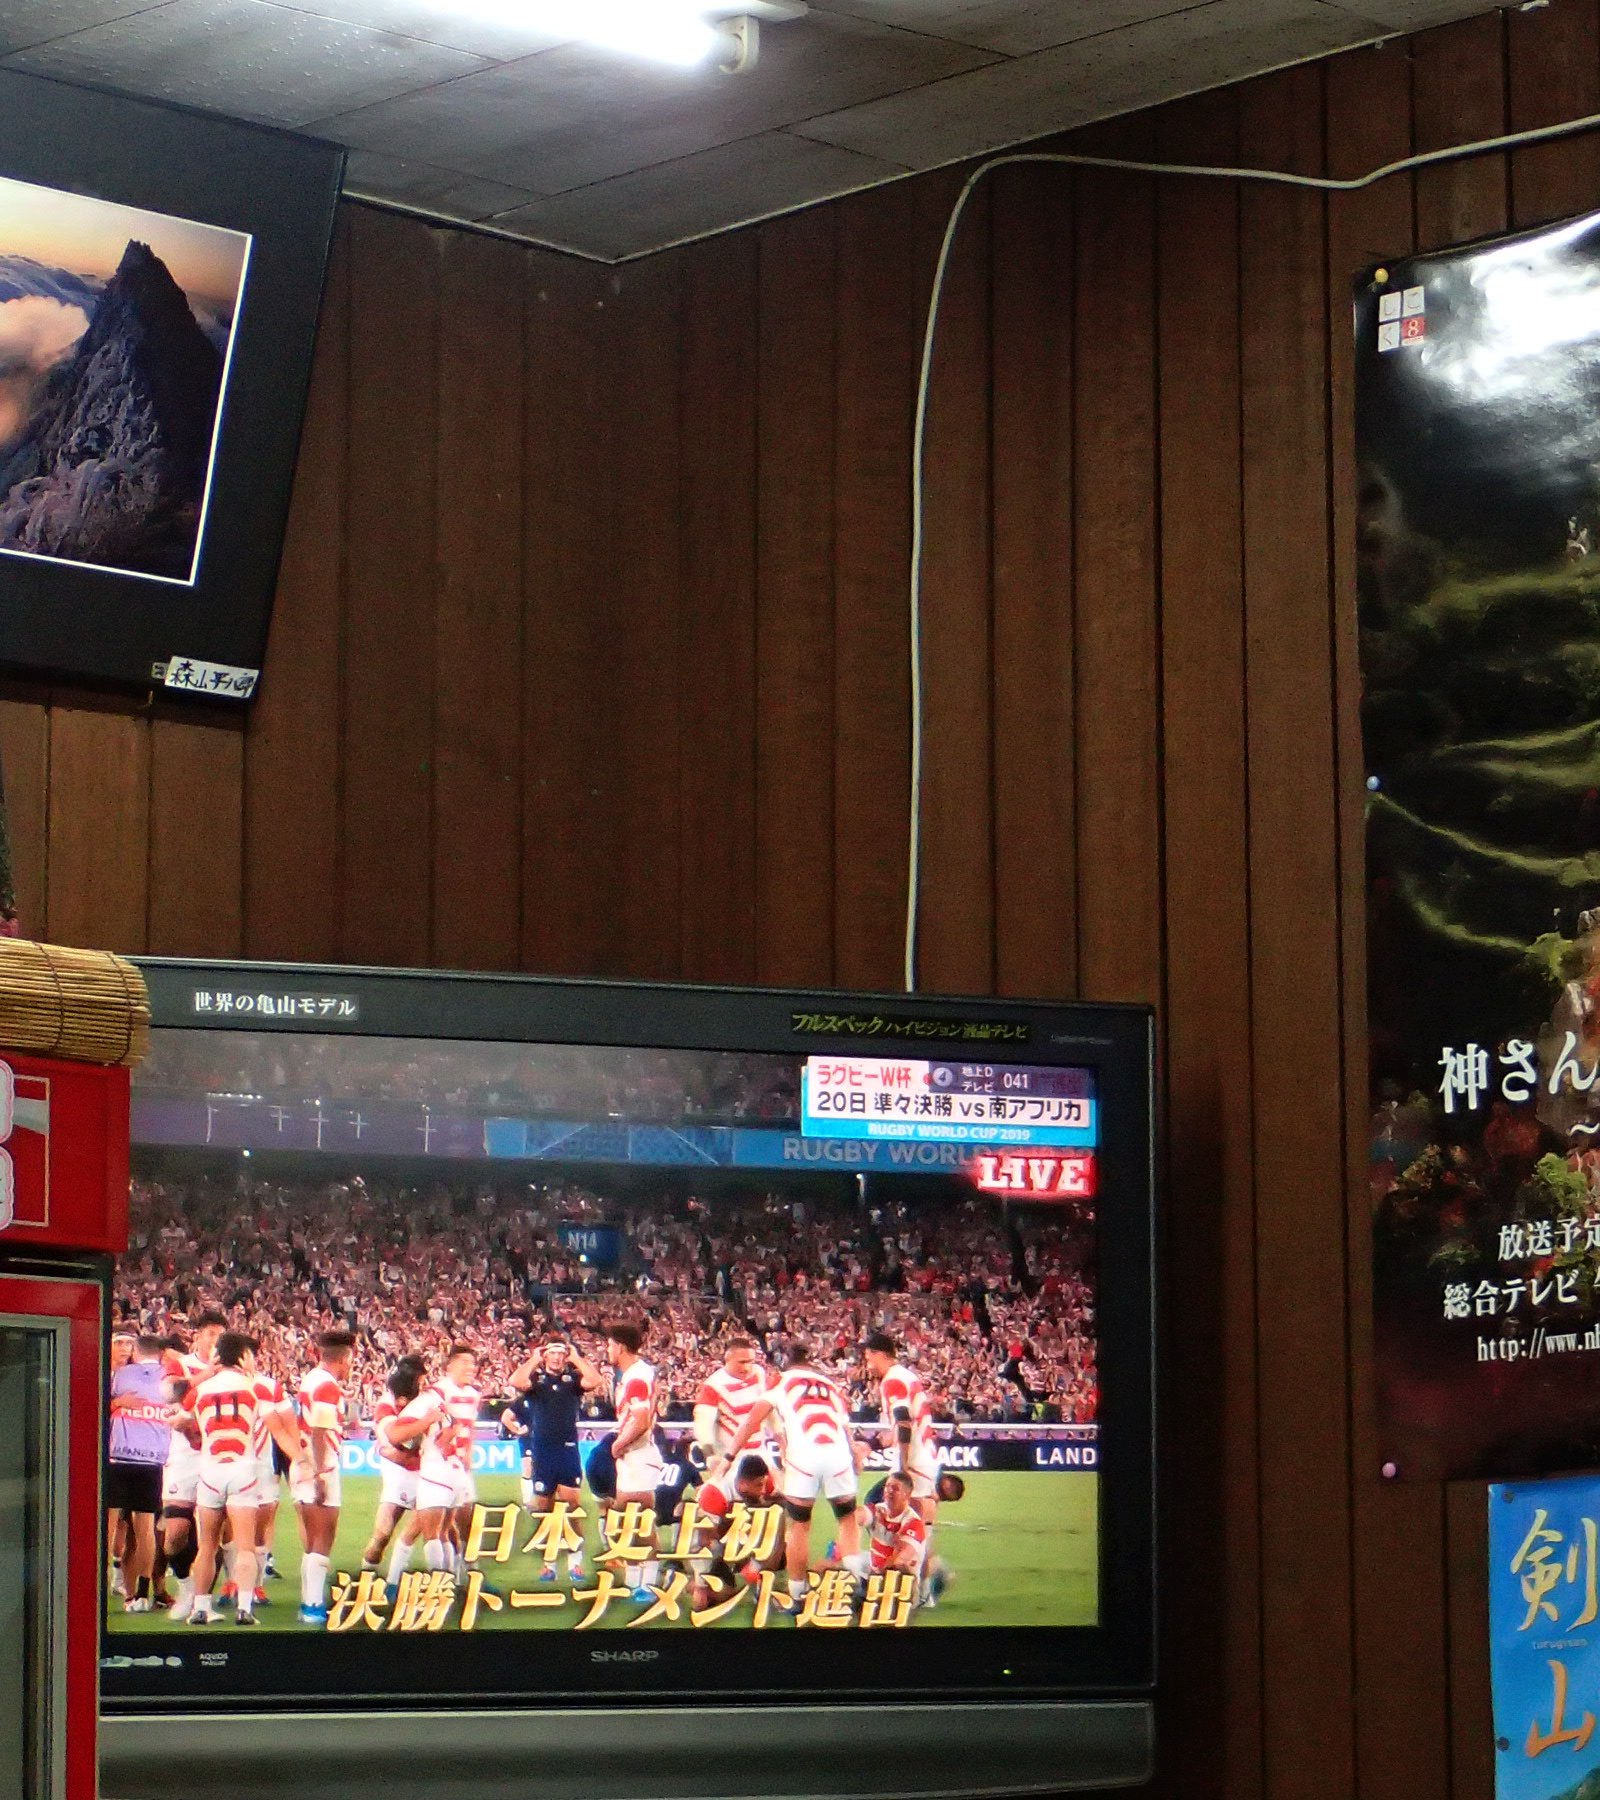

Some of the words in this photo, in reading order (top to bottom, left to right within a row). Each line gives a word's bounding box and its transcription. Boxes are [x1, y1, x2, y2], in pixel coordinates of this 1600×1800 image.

[195, 991, 355, 1016] 世界の亀山モデル
[818, 1064, 911, 1089] ラグビーW杯
[961, 1081, 994, 1093] テレビ
[1003, 1070, 1029, 1089] 041
[817, 1091, 866, 1113] 20日
[874, 1092, 952, 1117] 準々決勝
[989, 1096, 1082, 1122] 南アフリカ
[868, 1123, 914, 1137] RUGBY
[919, 1125, 967, 1139] WORLD
[971, 1127, 997, 1139] CUP
[1000, 1128, 1030, 1141] 2019
[783, 1137, 878, 1163] RUGBY
[978, 1156, 1087, 1191] LIVE
[567, 1231, 598, 1250] N14
[1443, 1269, 1579, 1319] 総合テレビ
[803, 1378, 830, 1399] 20
[214, 1393, 239, 1422] 11
[1036, 1447, 1097, 1466] LAND
[464, 1502, 787, 1563] 日本史上初
[326, 1570, 918, 1632] 決勝トーナメント進出
[590, 1650, 659, 1662] SHARP
